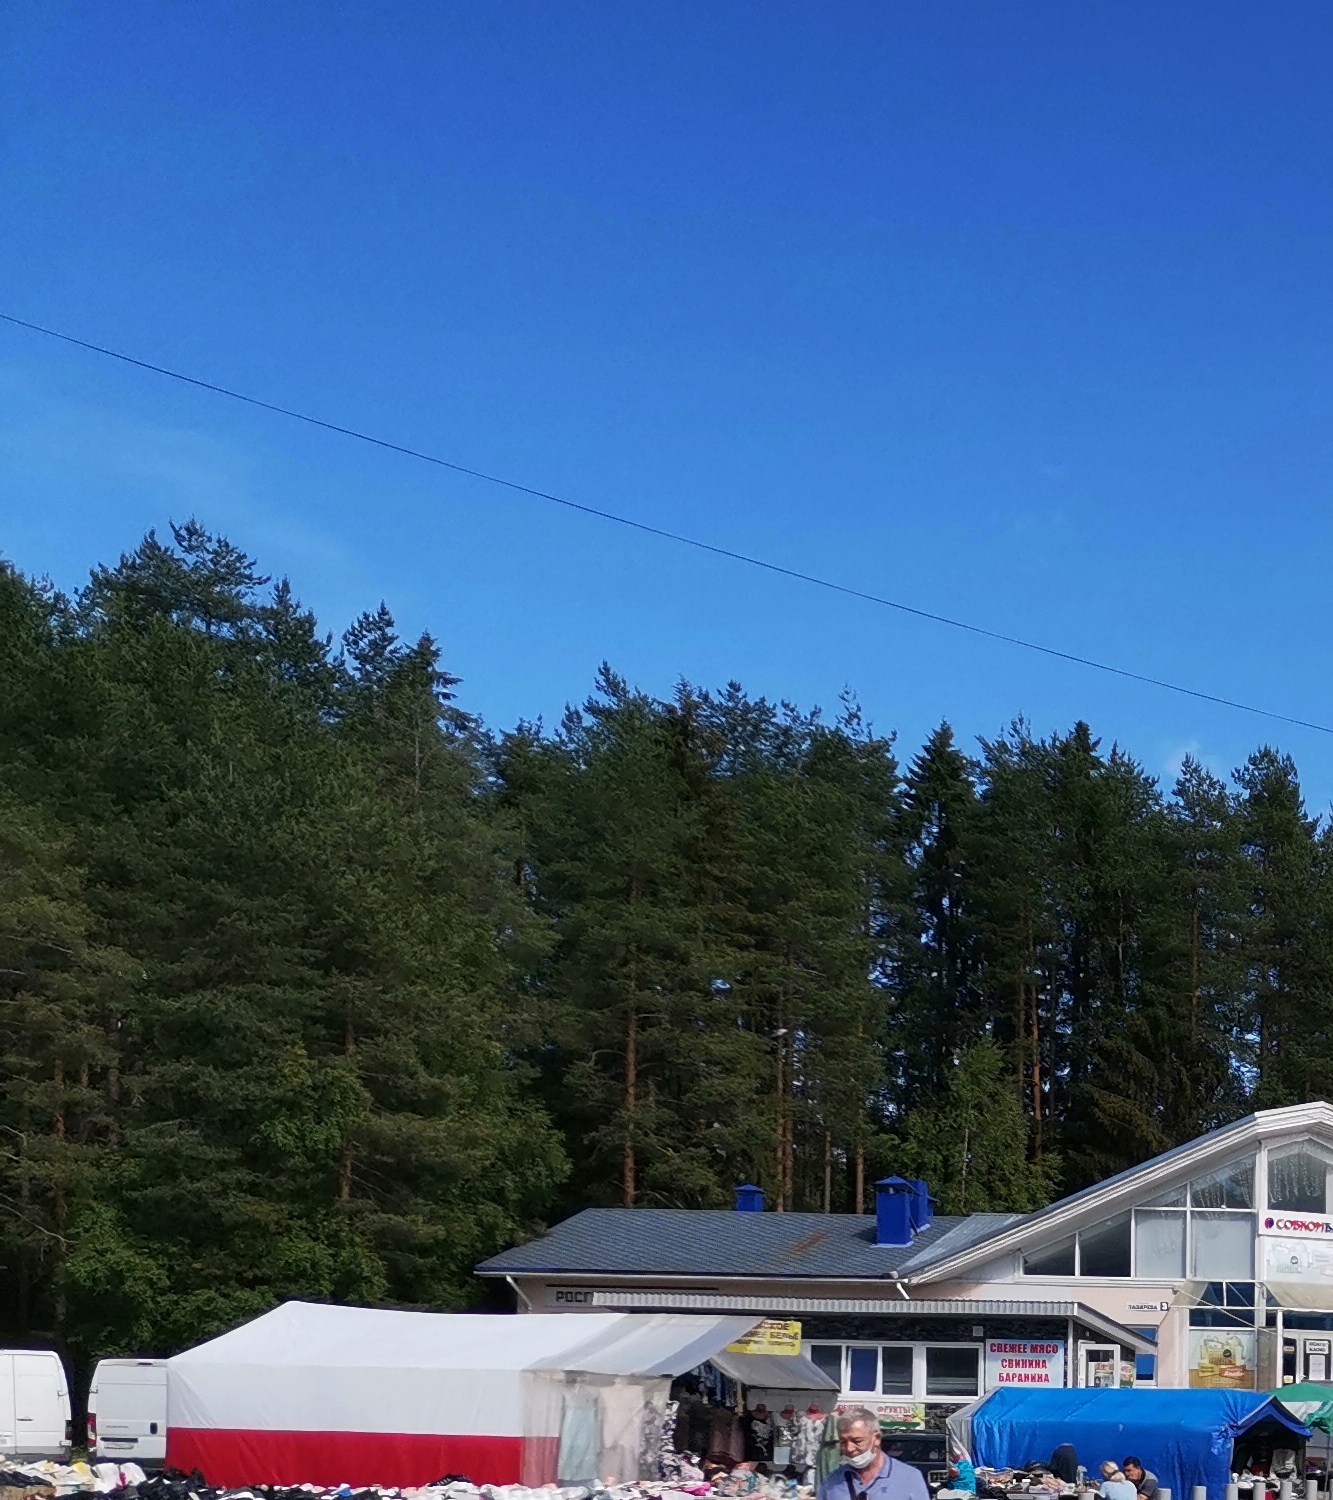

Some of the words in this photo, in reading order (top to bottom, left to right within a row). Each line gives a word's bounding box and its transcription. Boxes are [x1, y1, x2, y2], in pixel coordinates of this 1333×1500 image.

[990, 1342, 1028, 1354] СВЕЖЕЕ
[1030, 1343, 1059, 1354] МЯСО
[1001, 1358, 1048, 1369] СВИНИНА
[998, 1372, 1050, 1383] БАРАНИНА
